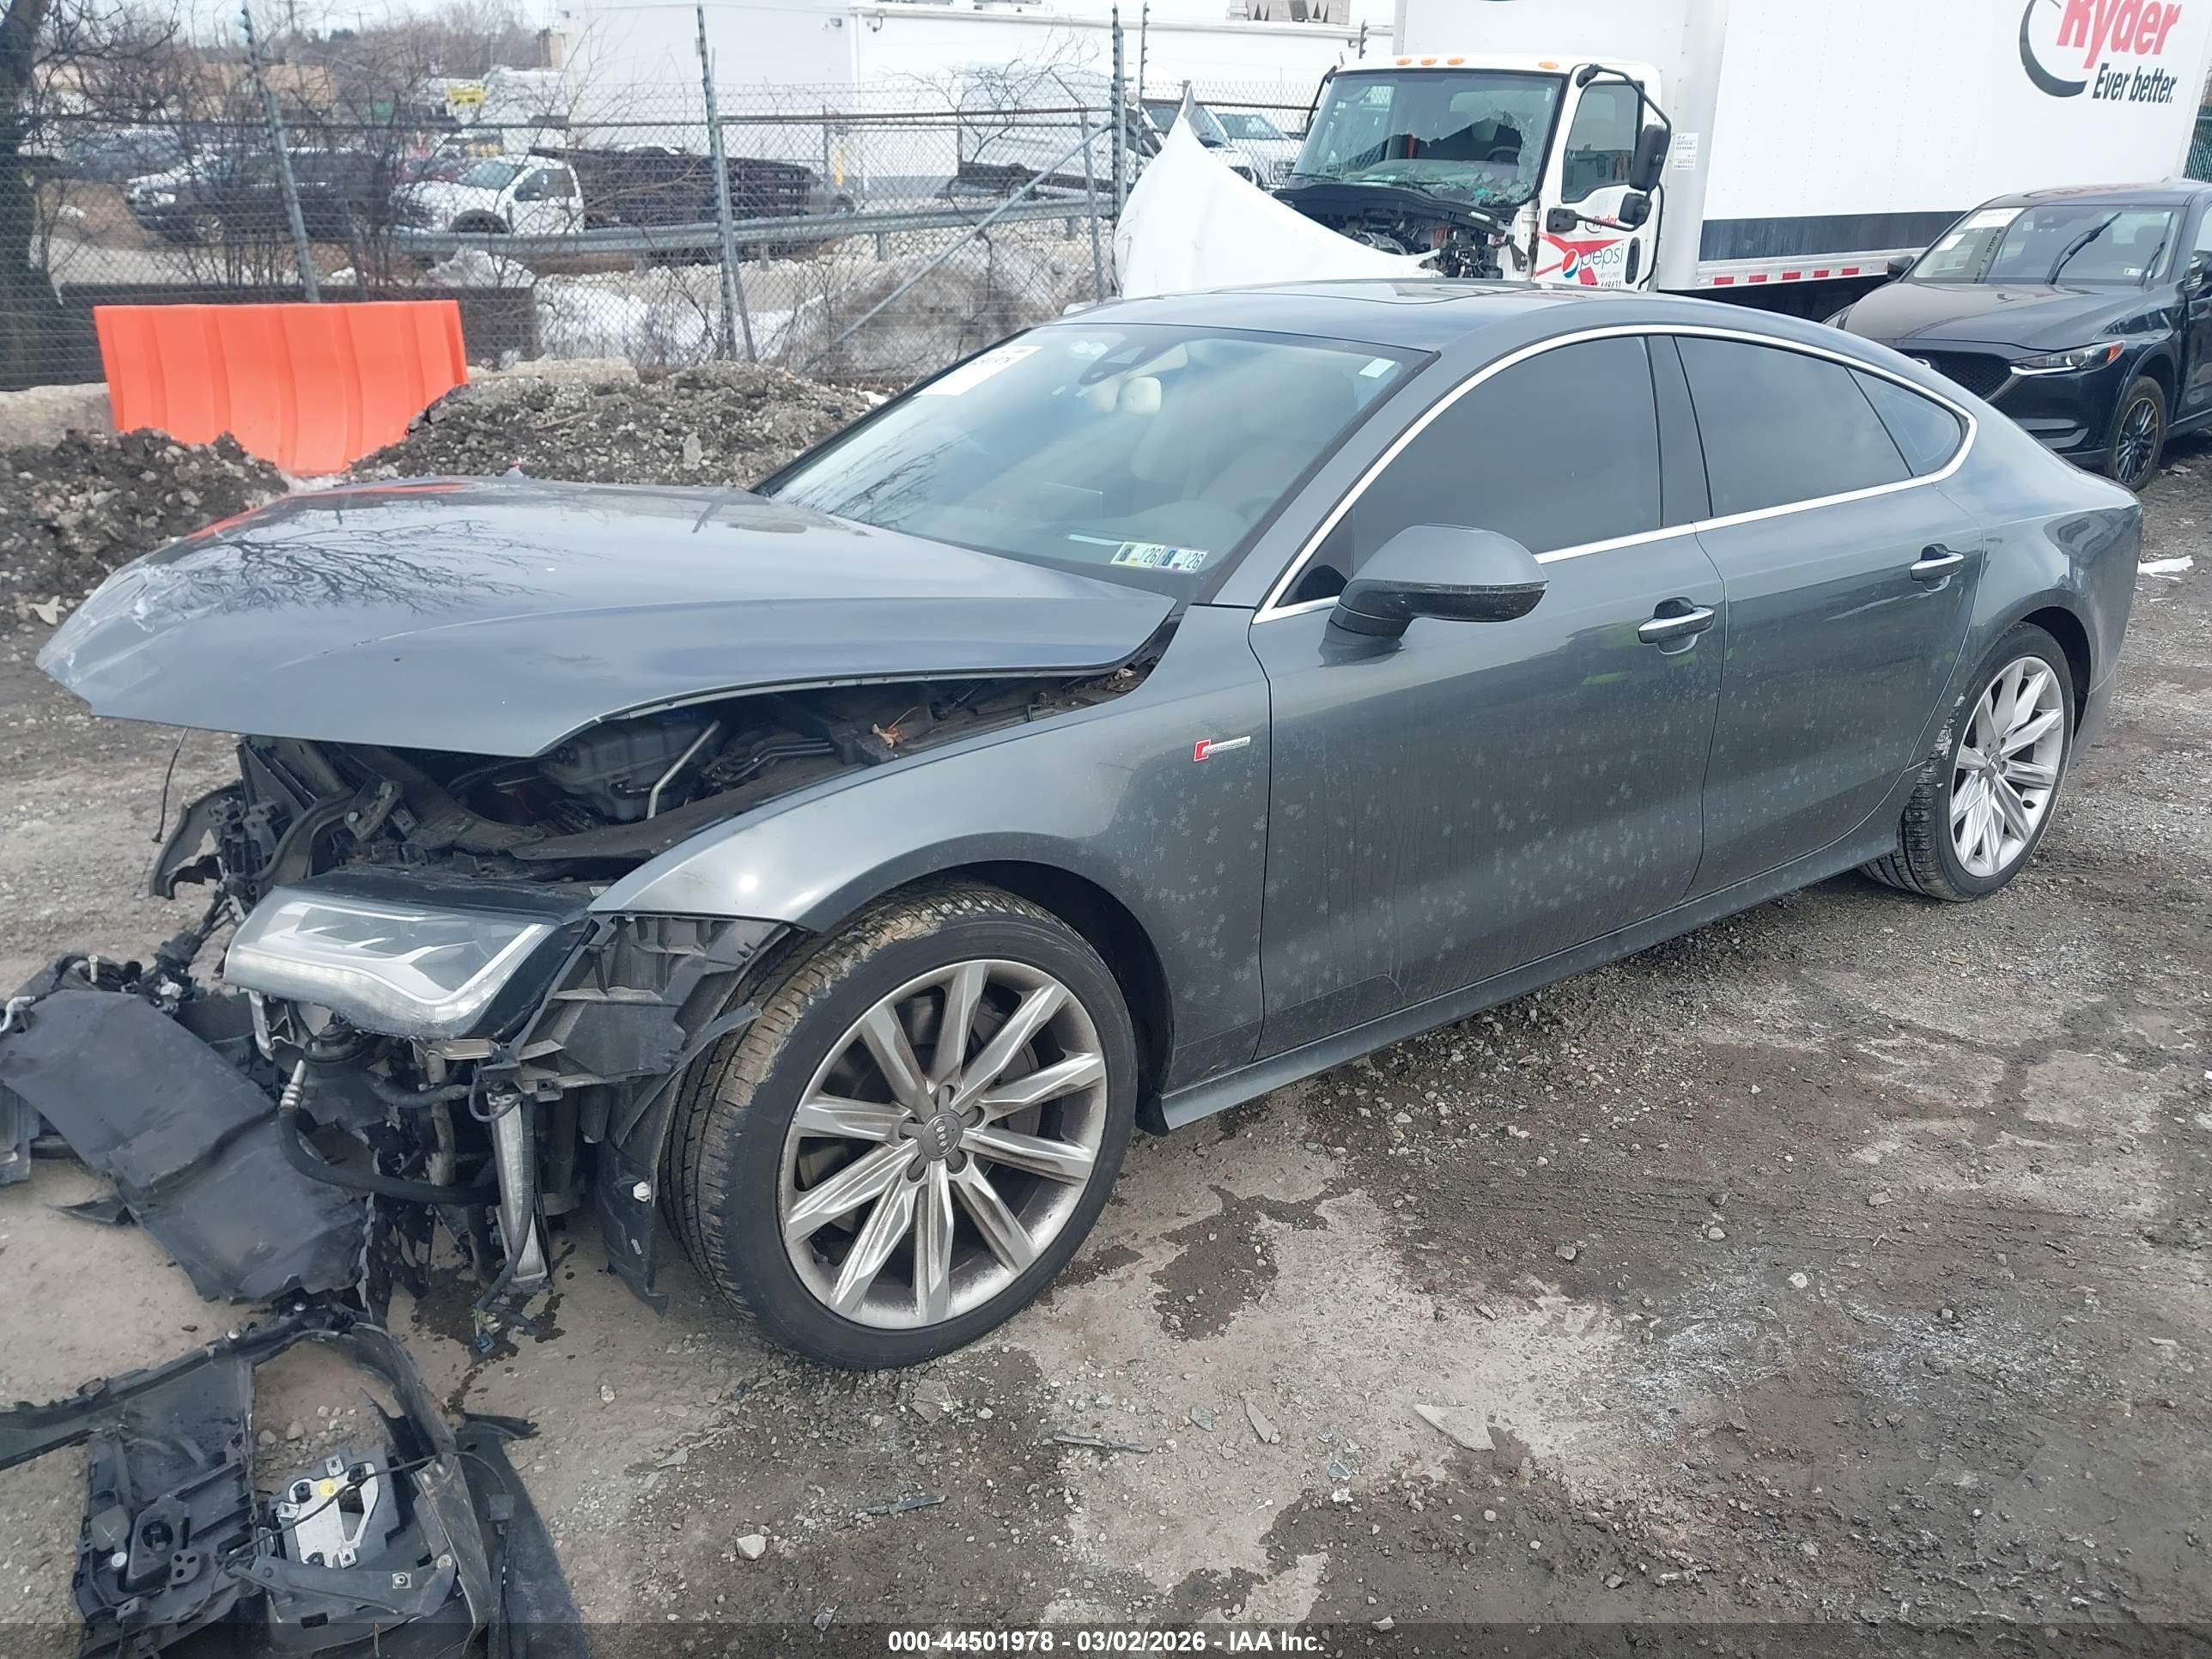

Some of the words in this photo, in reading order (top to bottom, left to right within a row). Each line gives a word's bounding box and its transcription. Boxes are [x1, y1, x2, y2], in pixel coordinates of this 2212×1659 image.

[2057, 0, 2182, 69] Ryder
[2092, 63, 2131, 100] Ever
[2128, 65, 2178, 103] better.
[1580, 242, 1624, 270] pepsi
